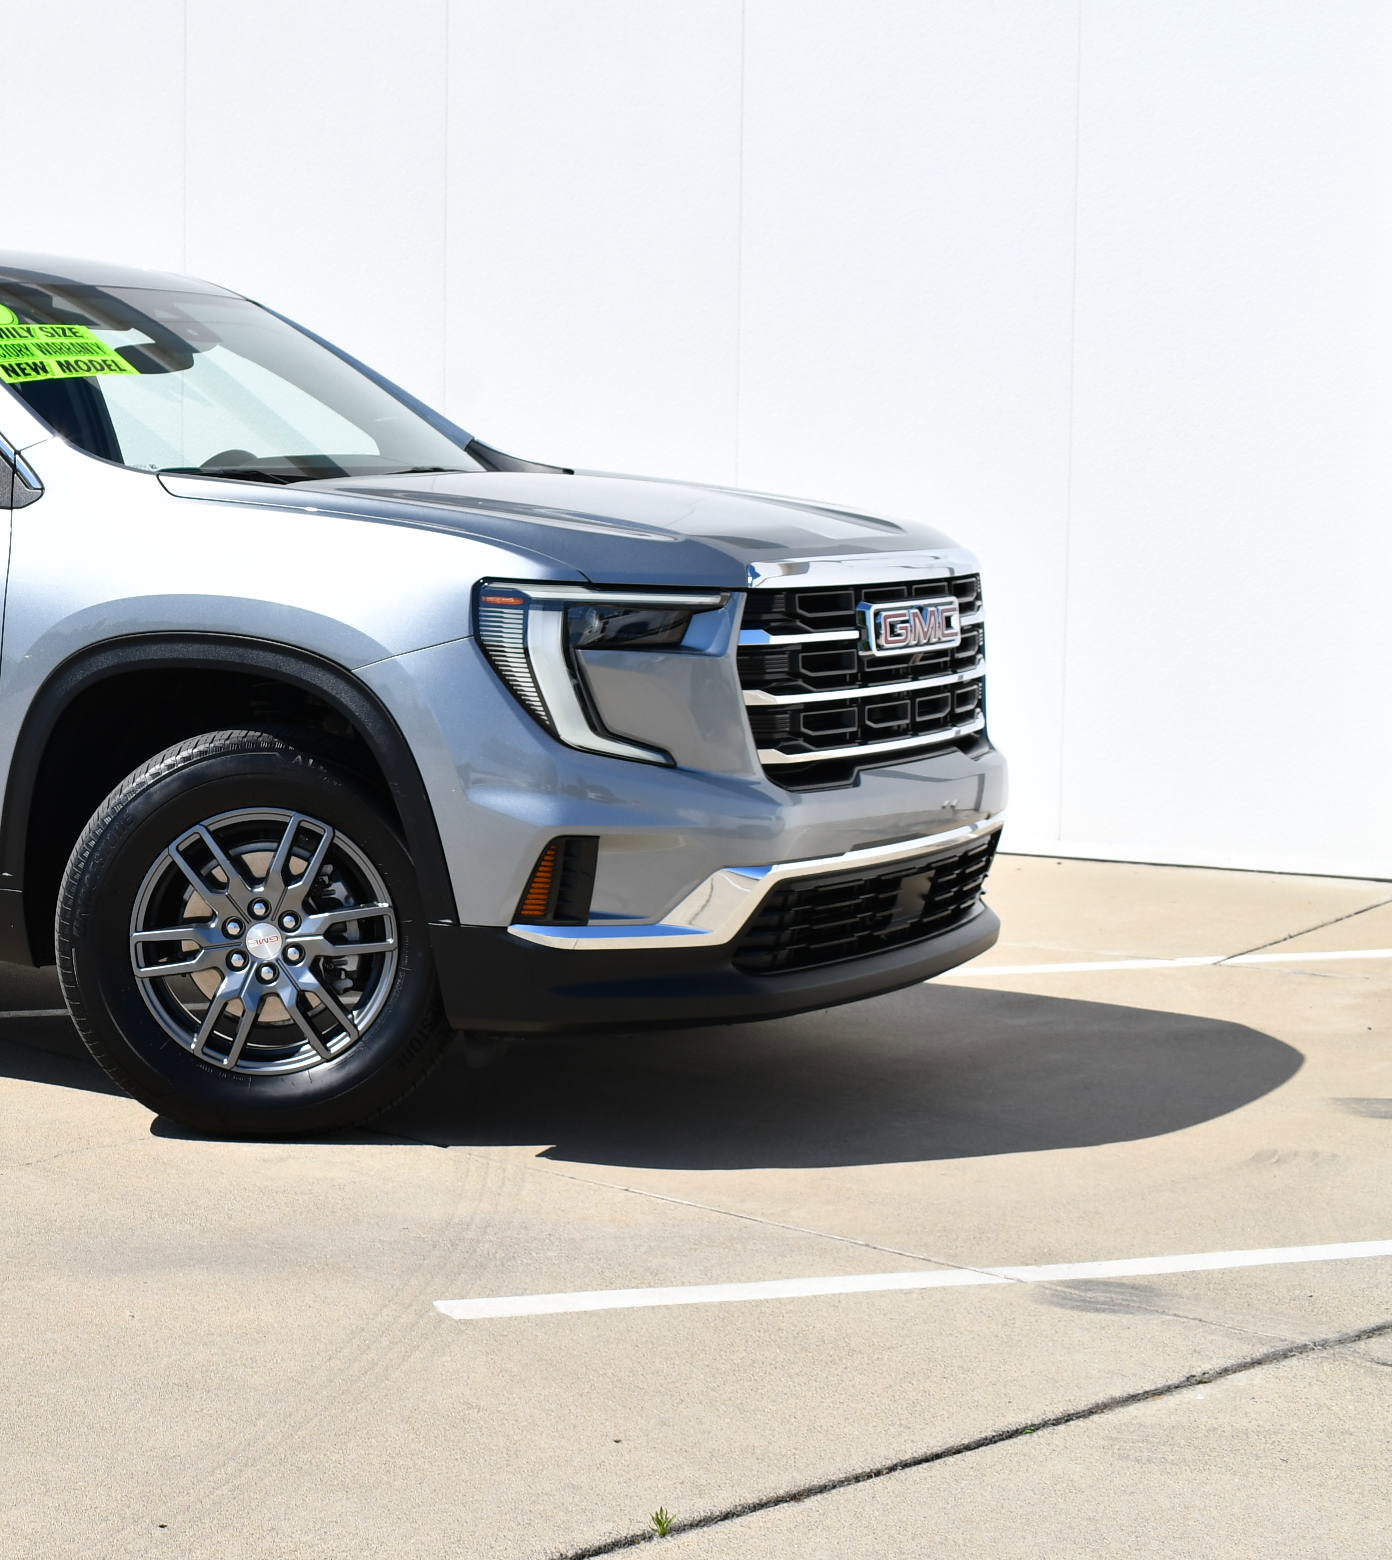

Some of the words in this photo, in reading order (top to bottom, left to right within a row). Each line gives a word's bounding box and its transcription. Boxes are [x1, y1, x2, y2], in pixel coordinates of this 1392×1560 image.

[39, 326, 84, 339] SIZE
[32, 342, 106, 357] WARRANTY
[0, 361, 49, 379] NEW
[56, 359, 128, 374] MODEL
[877, 604, 959, 648] GMC
